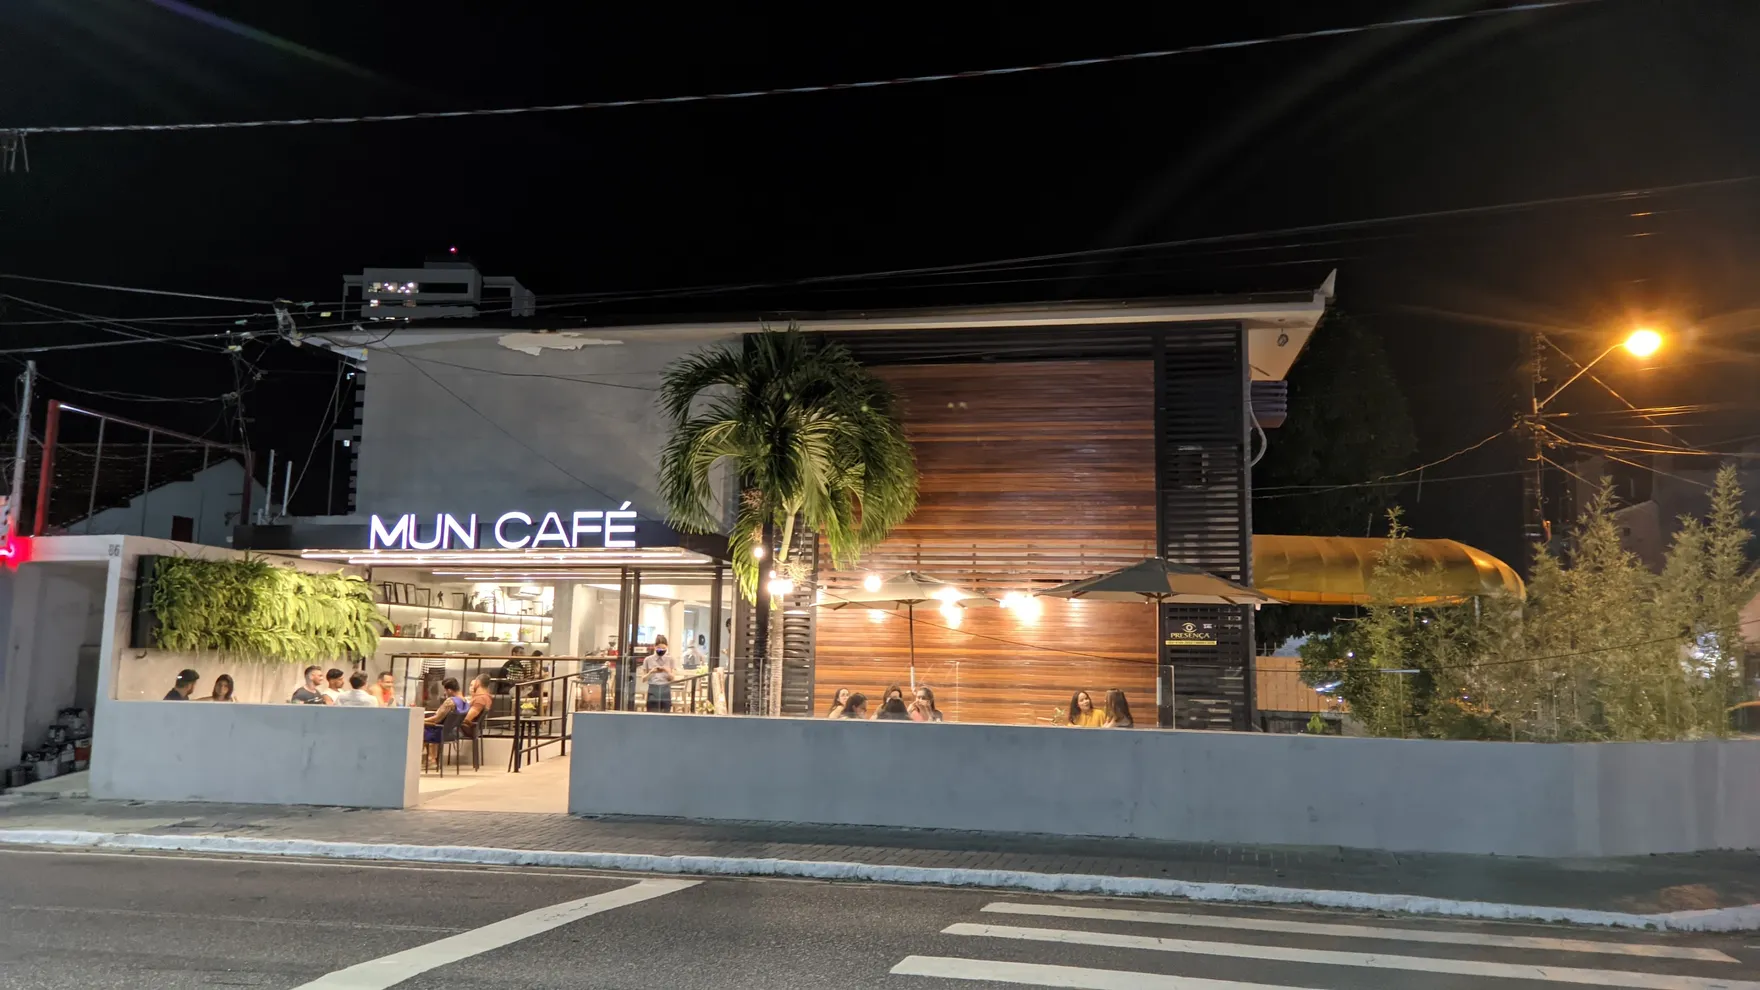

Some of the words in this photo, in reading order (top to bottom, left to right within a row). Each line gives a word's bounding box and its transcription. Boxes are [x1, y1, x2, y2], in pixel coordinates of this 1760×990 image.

[369, 513, 477, 550] MUN
[494, 501, 637, 548] CAFÉ
[1170, 632, 1210, 640] PRESENÇA
